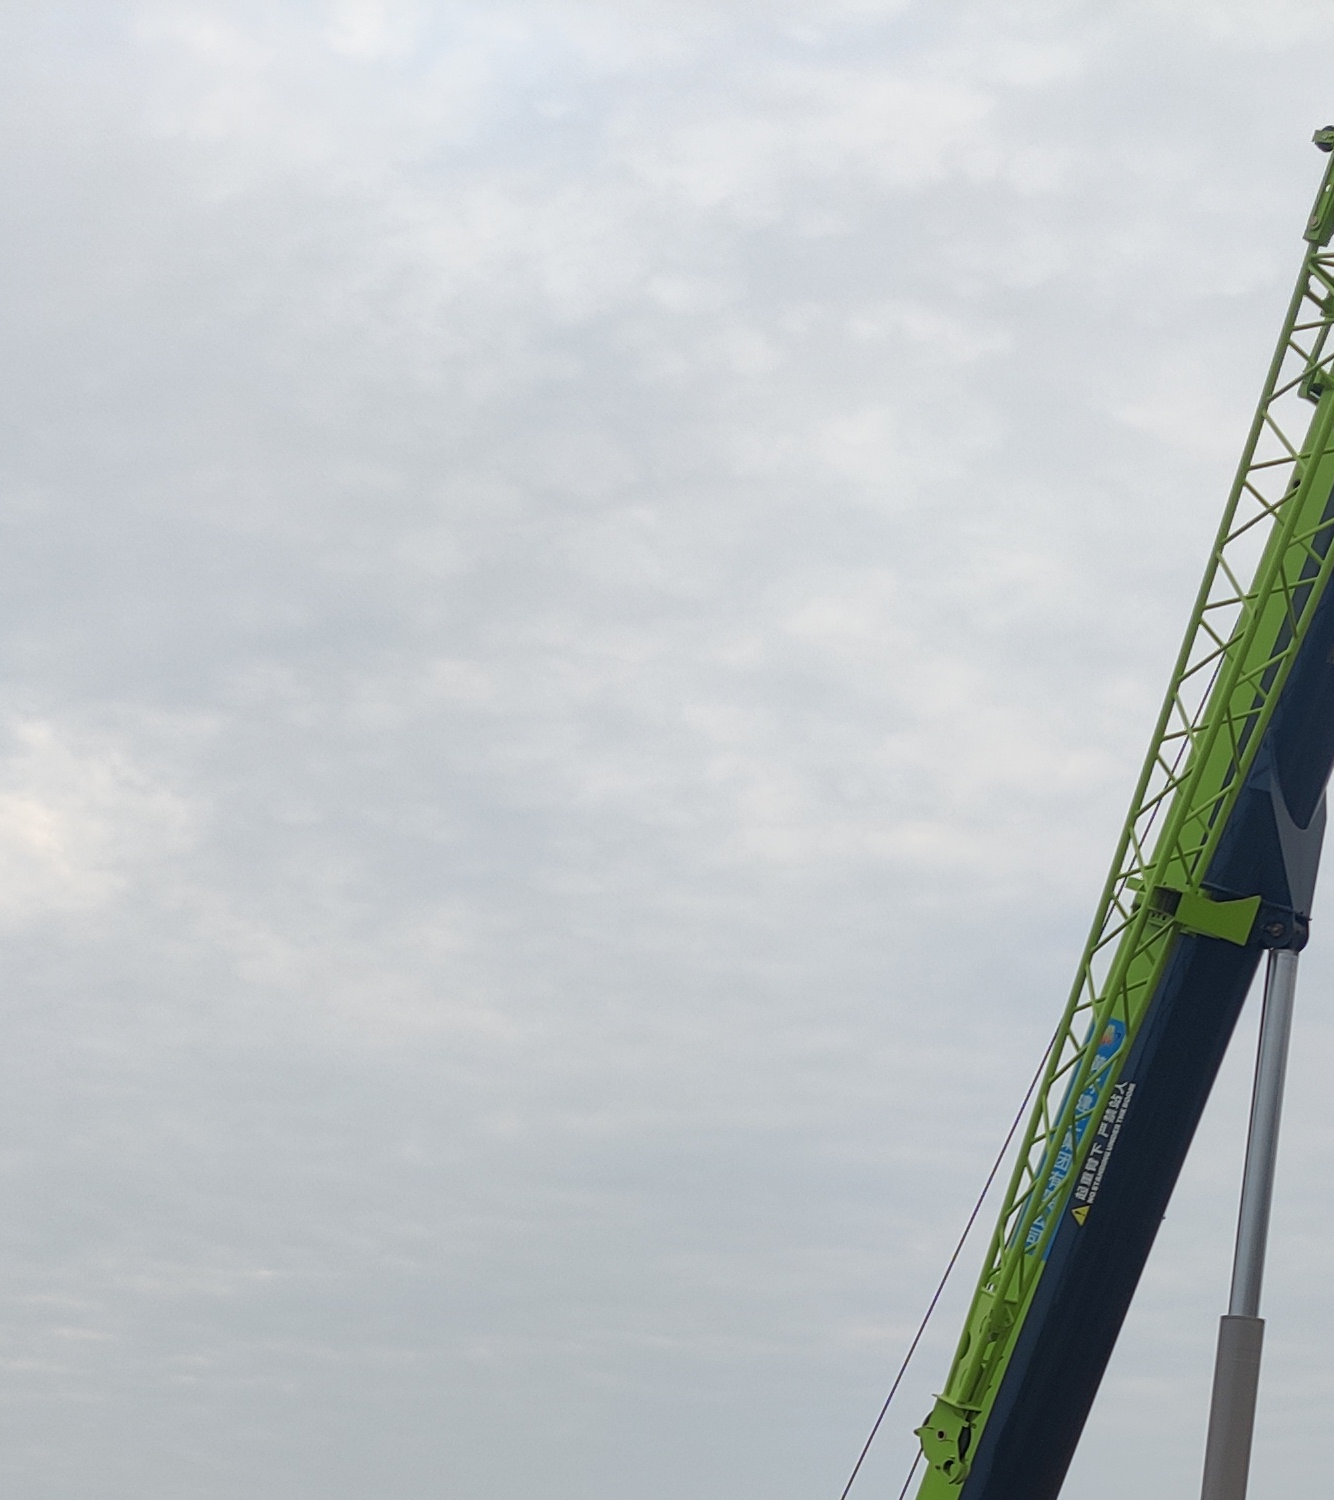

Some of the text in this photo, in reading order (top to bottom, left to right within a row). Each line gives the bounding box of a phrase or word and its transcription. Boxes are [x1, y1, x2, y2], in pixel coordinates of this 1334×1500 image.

[1075, 1081, 1128, 1200] 起重臂下 严禁站人
